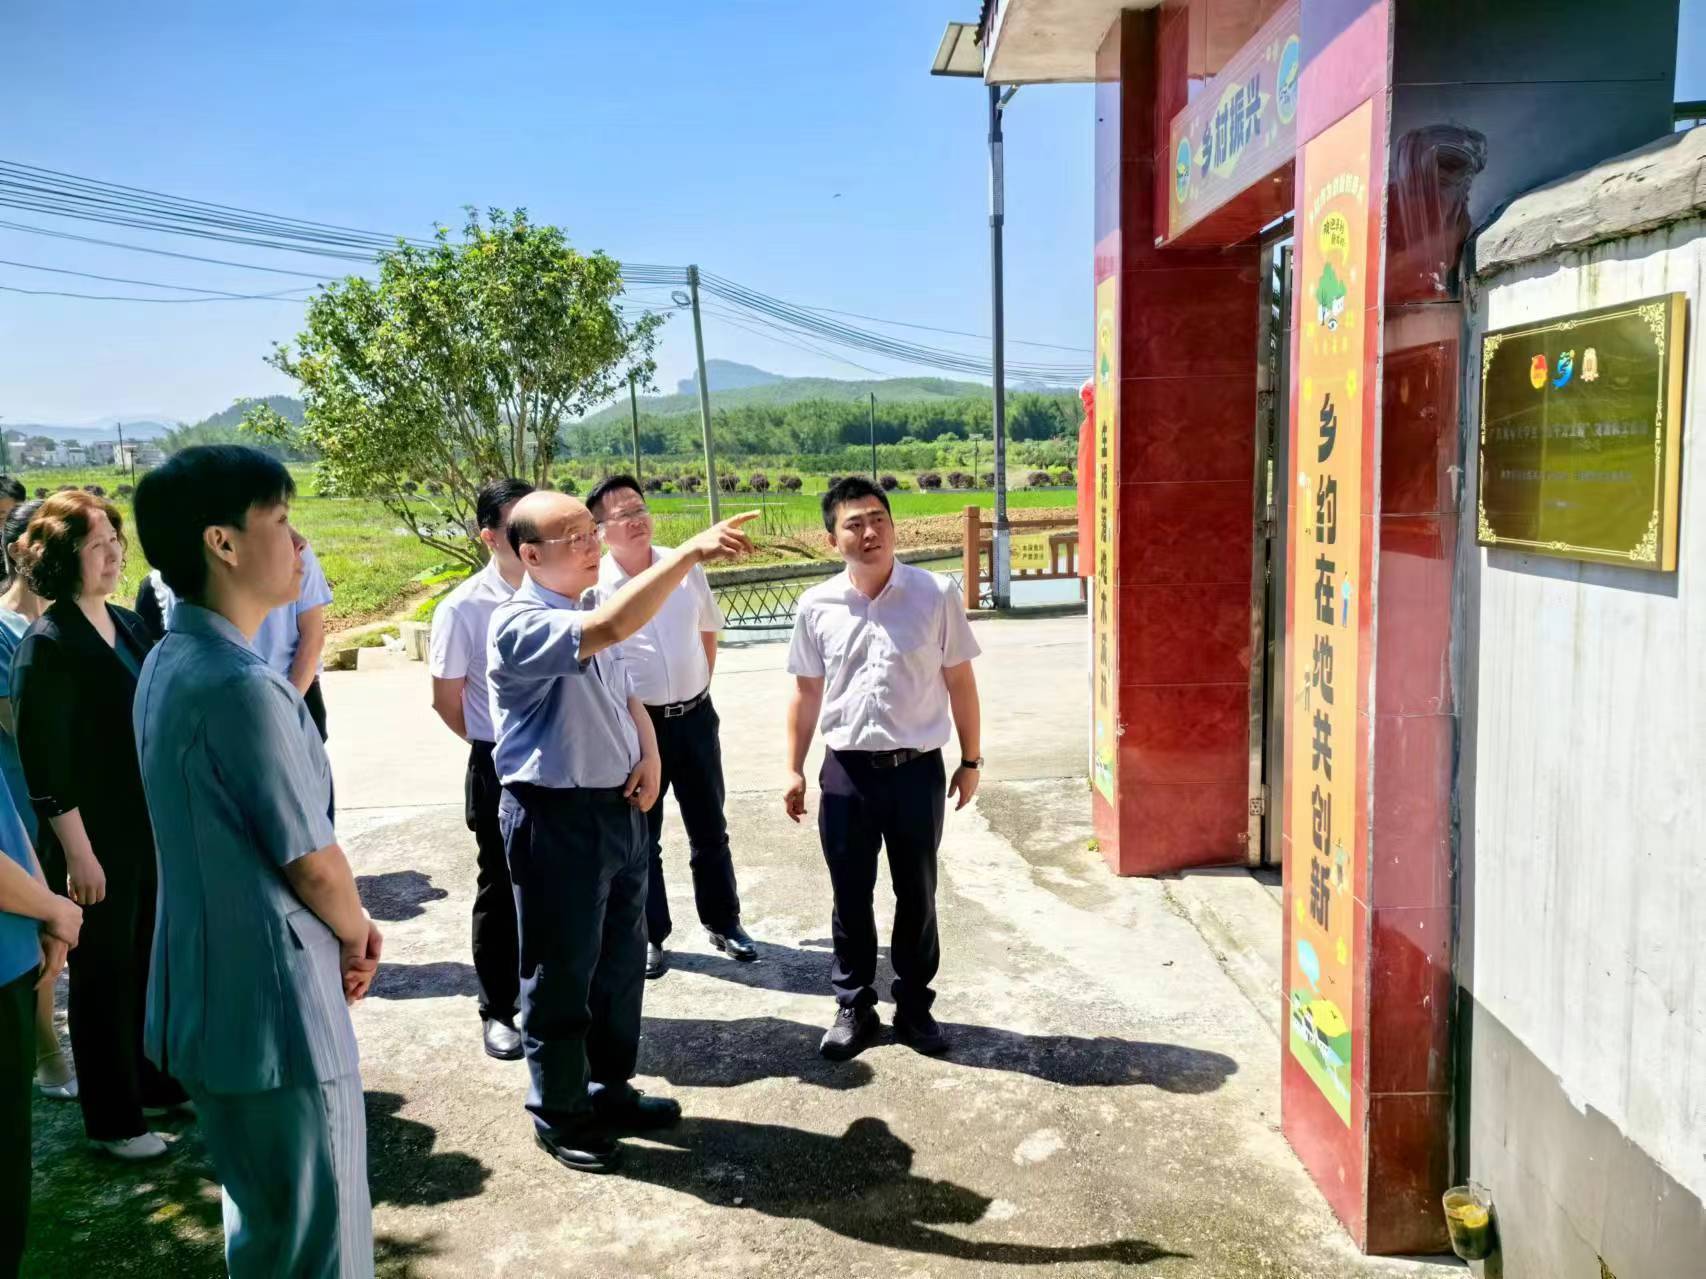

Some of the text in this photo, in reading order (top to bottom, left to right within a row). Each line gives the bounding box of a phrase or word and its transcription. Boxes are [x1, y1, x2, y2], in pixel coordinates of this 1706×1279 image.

[1201, 72, 1261, 177] 乡村振兴
[1309, 393, 1338, 932] 乡约在地共创新
